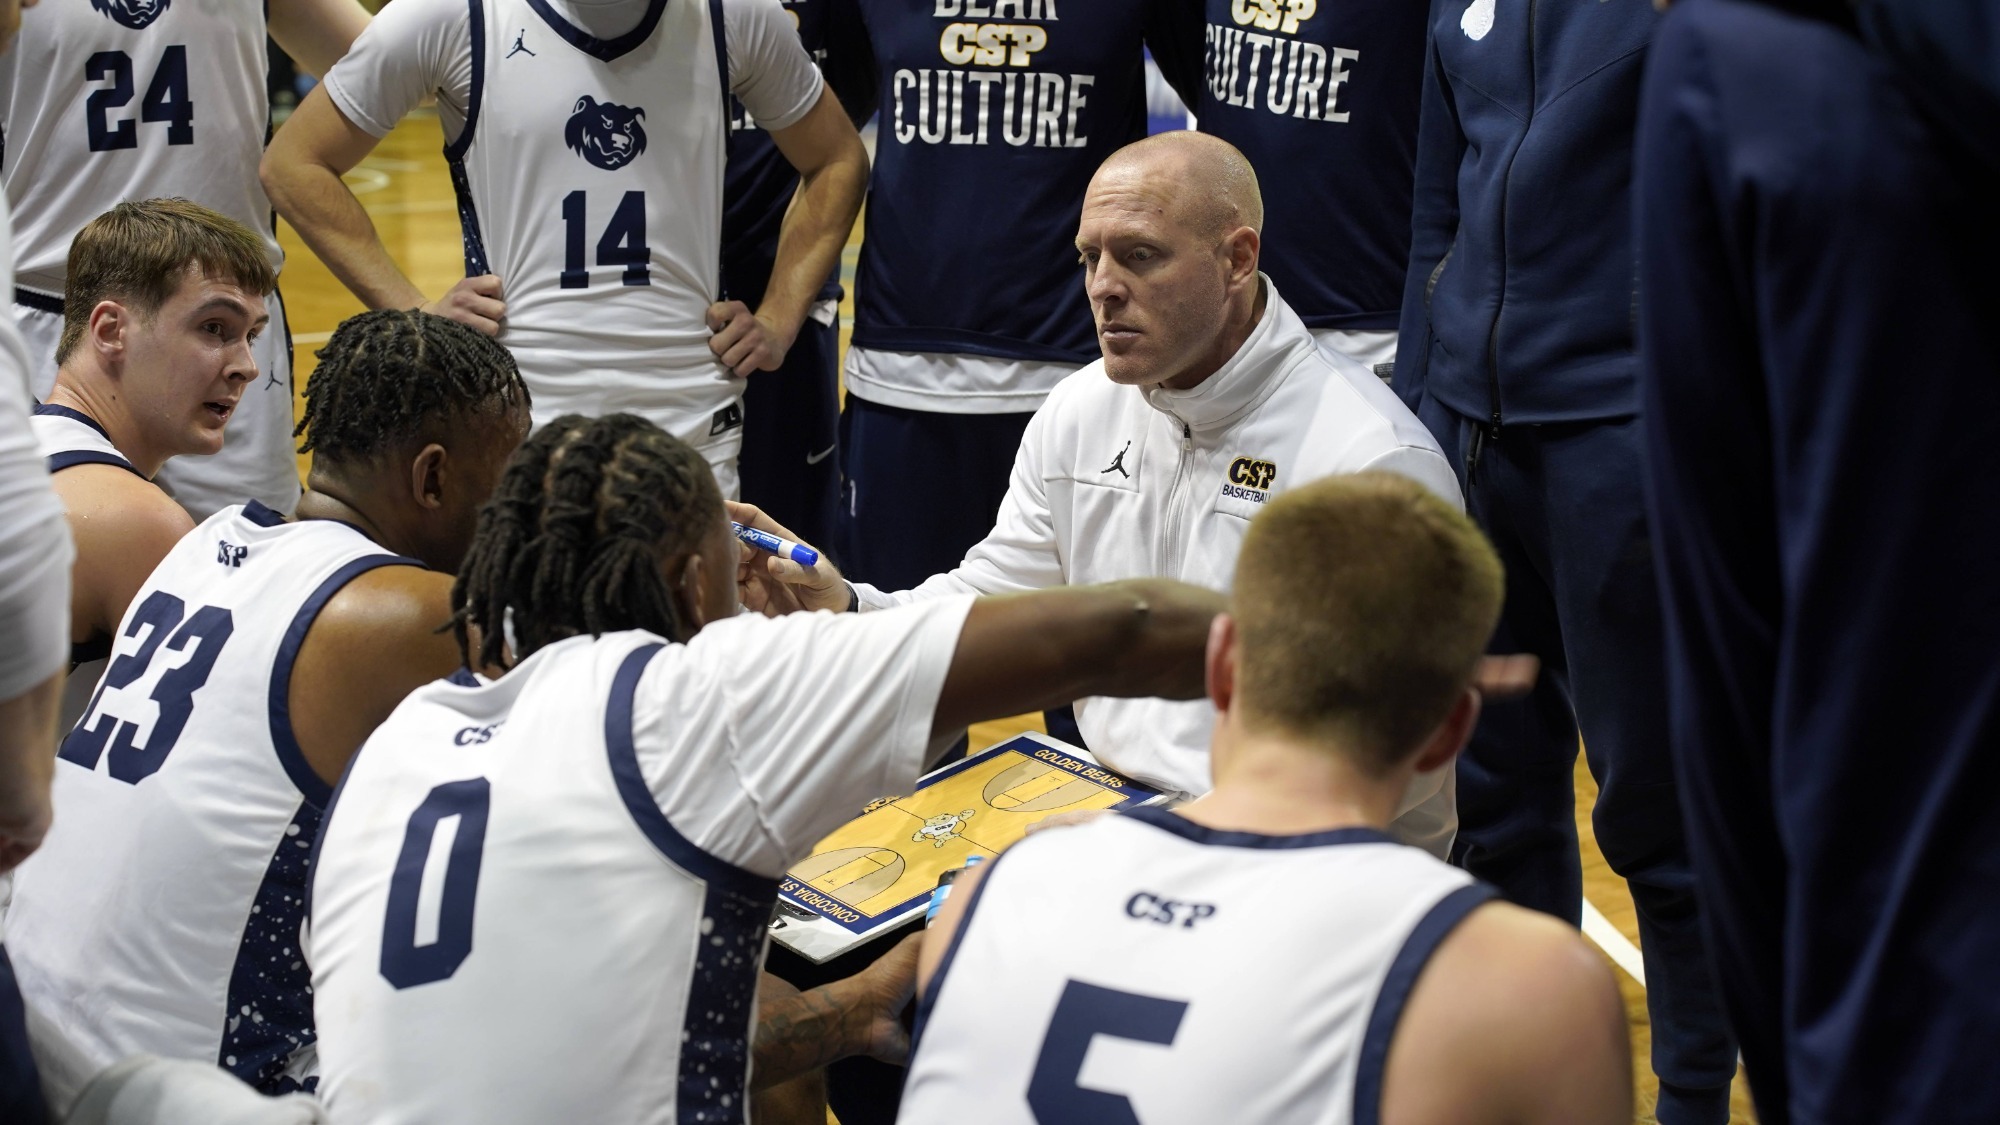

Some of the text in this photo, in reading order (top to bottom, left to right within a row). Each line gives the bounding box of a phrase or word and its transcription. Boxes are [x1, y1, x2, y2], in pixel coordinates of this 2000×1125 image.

[939, 22, 1048, 67] CSP
[86, 45, 194, 153] 24
[894, 68, 1095, 148] CULTURE
[560, 190, 651, 288] 14
[1228, 456, 1277, 491] CSP
[56, 590, 235, 785] 23
[454, 720, 506, 746] CS
[1034, 749, 1125, 788] GOLDEN BEARS
[380, 776, 491, 990] 0
[794, 887, 860, 923] CONCORDIA
[1124, 891, 1217, 929] CSP
[1026, 978, 1190, 1125] 5
